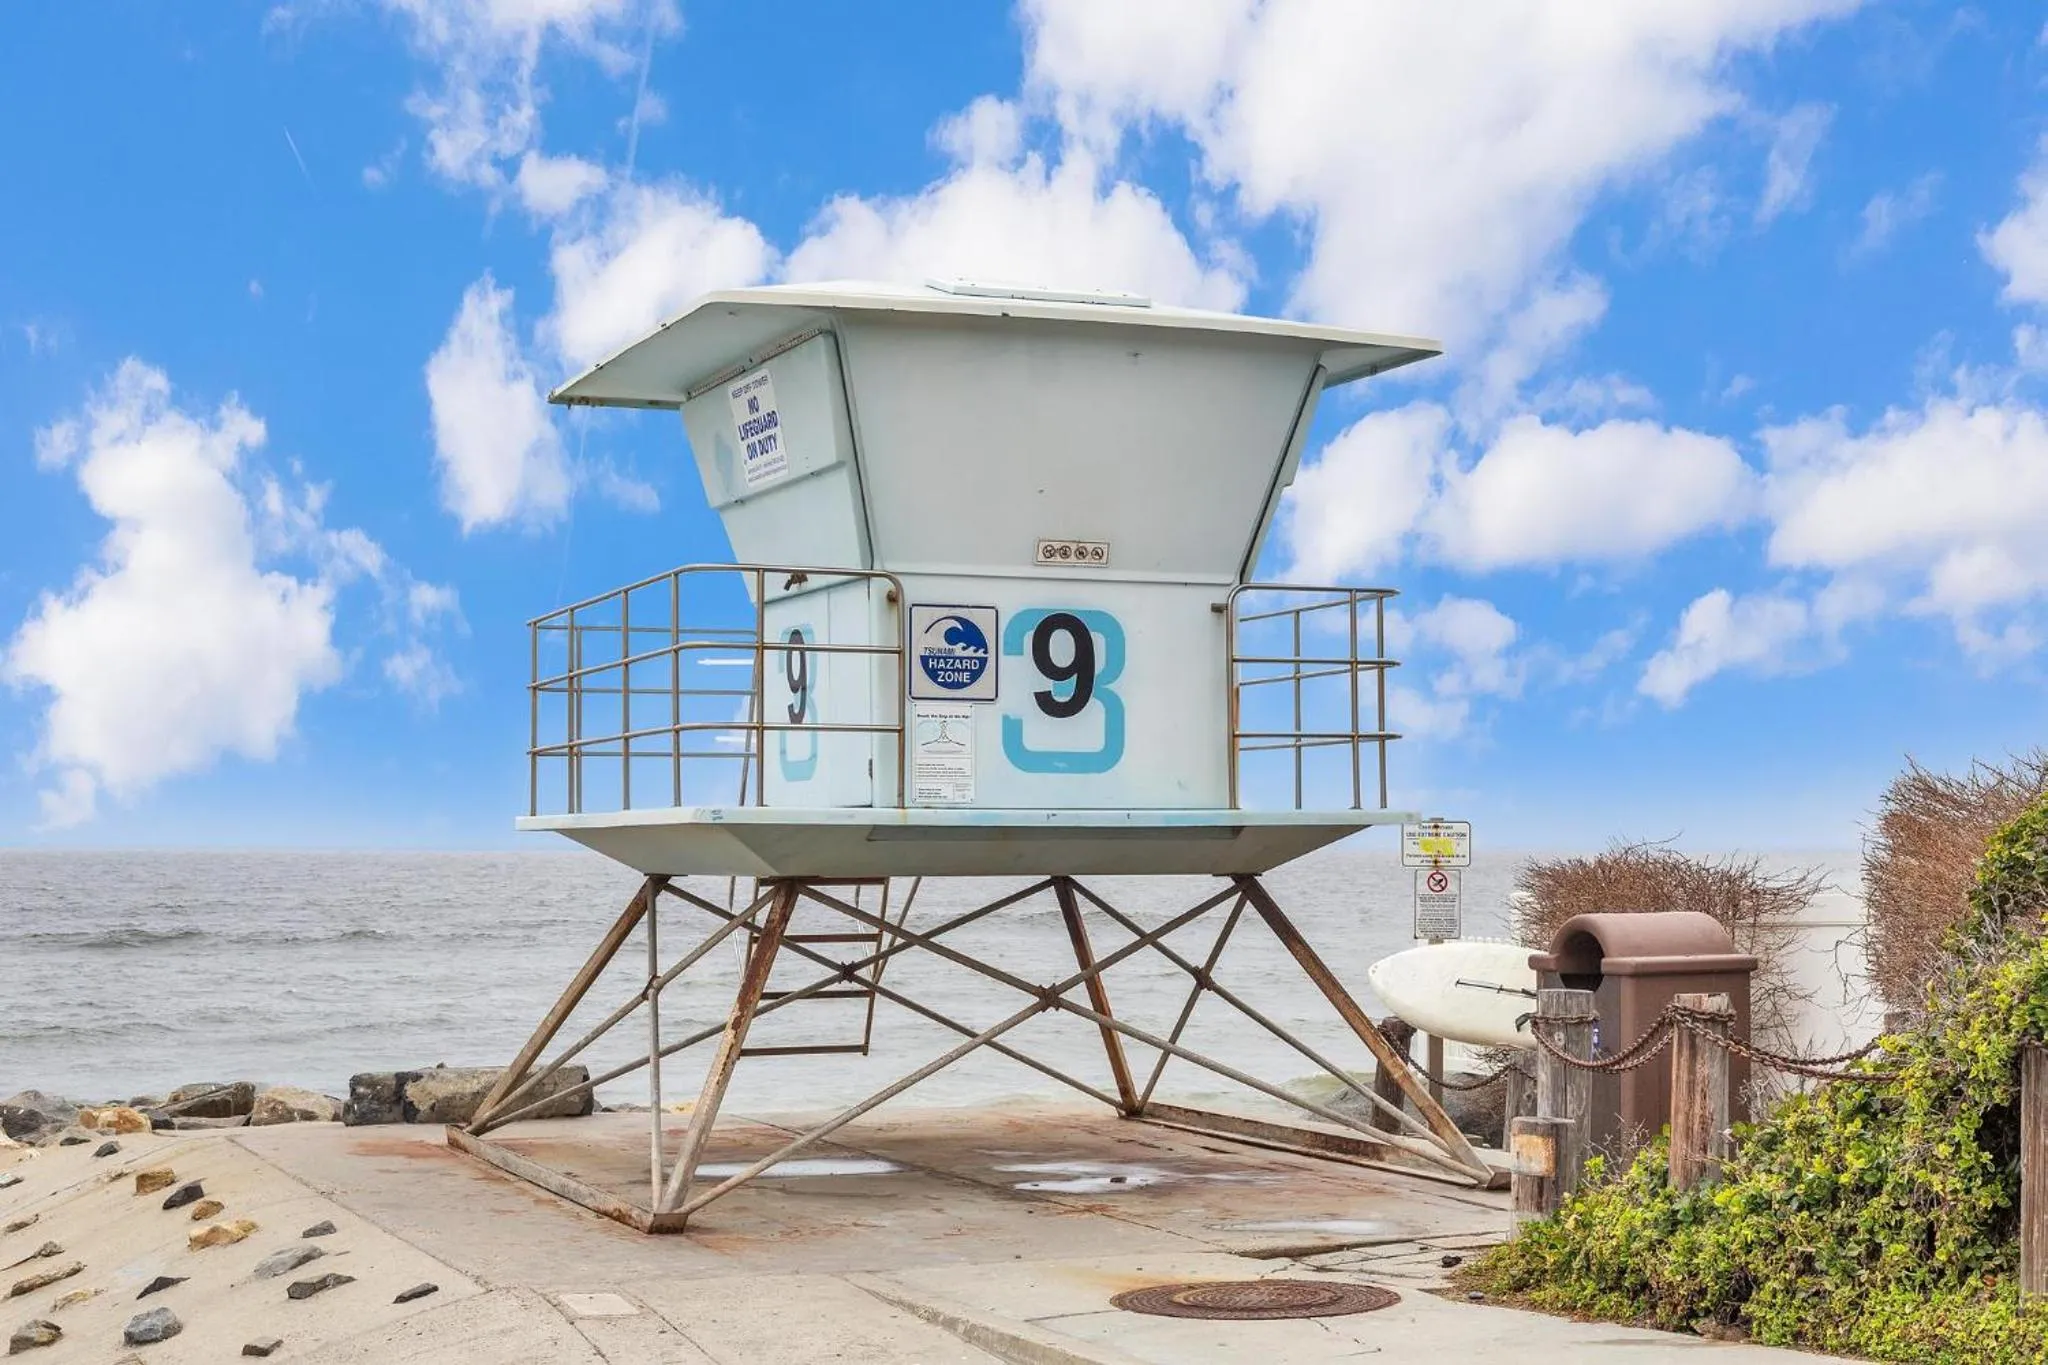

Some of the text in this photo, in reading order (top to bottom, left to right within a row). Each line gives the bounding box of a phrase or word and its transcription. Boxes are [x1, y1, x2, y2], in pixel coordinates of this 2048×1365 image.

[748, 395, 760, 415] NO
[738, 410, 778, 441] LIFEGUARD
[747, 432, 778, 460] ON DUTY
[924, 646, 955, 655] TSUNAMI
[928, 658, 980, 670] HAZARD
[1032, 613, 1095, 718] 9
[786, 629, 807, 725] 9
[937, 671, 971, 682] ZONE
